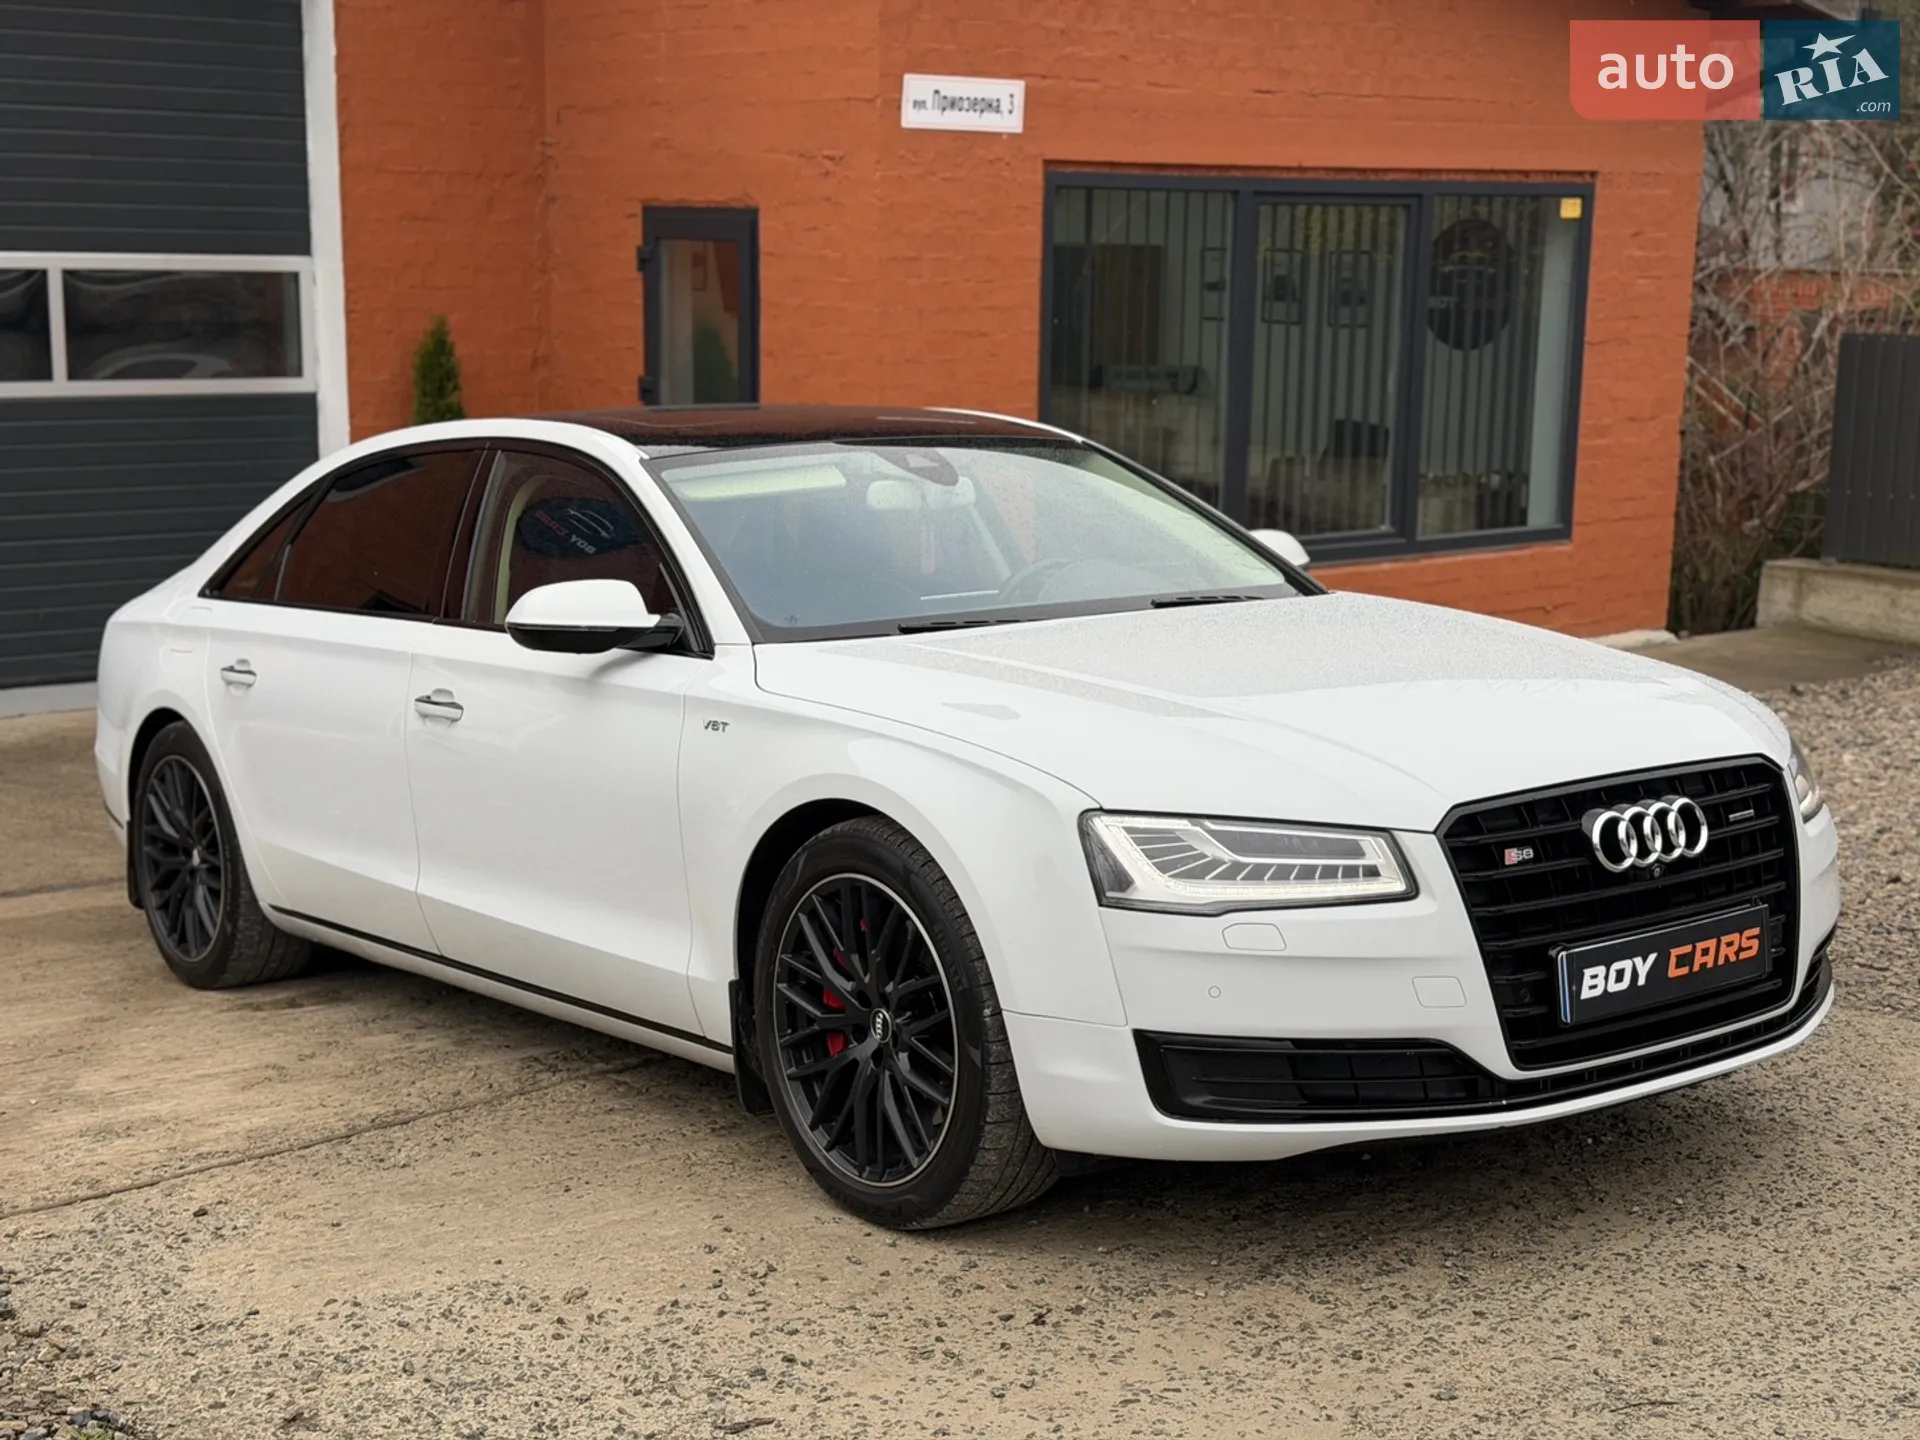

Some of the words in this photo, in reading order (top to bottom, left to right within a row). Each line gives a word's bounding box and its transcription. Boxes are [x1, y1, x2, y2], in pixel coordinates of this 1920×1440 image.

[1007, 93, 1014, 115] 3
[1580, 953, 1657, 1000] BOY
[1667, 927, 1760, 979] CARS
